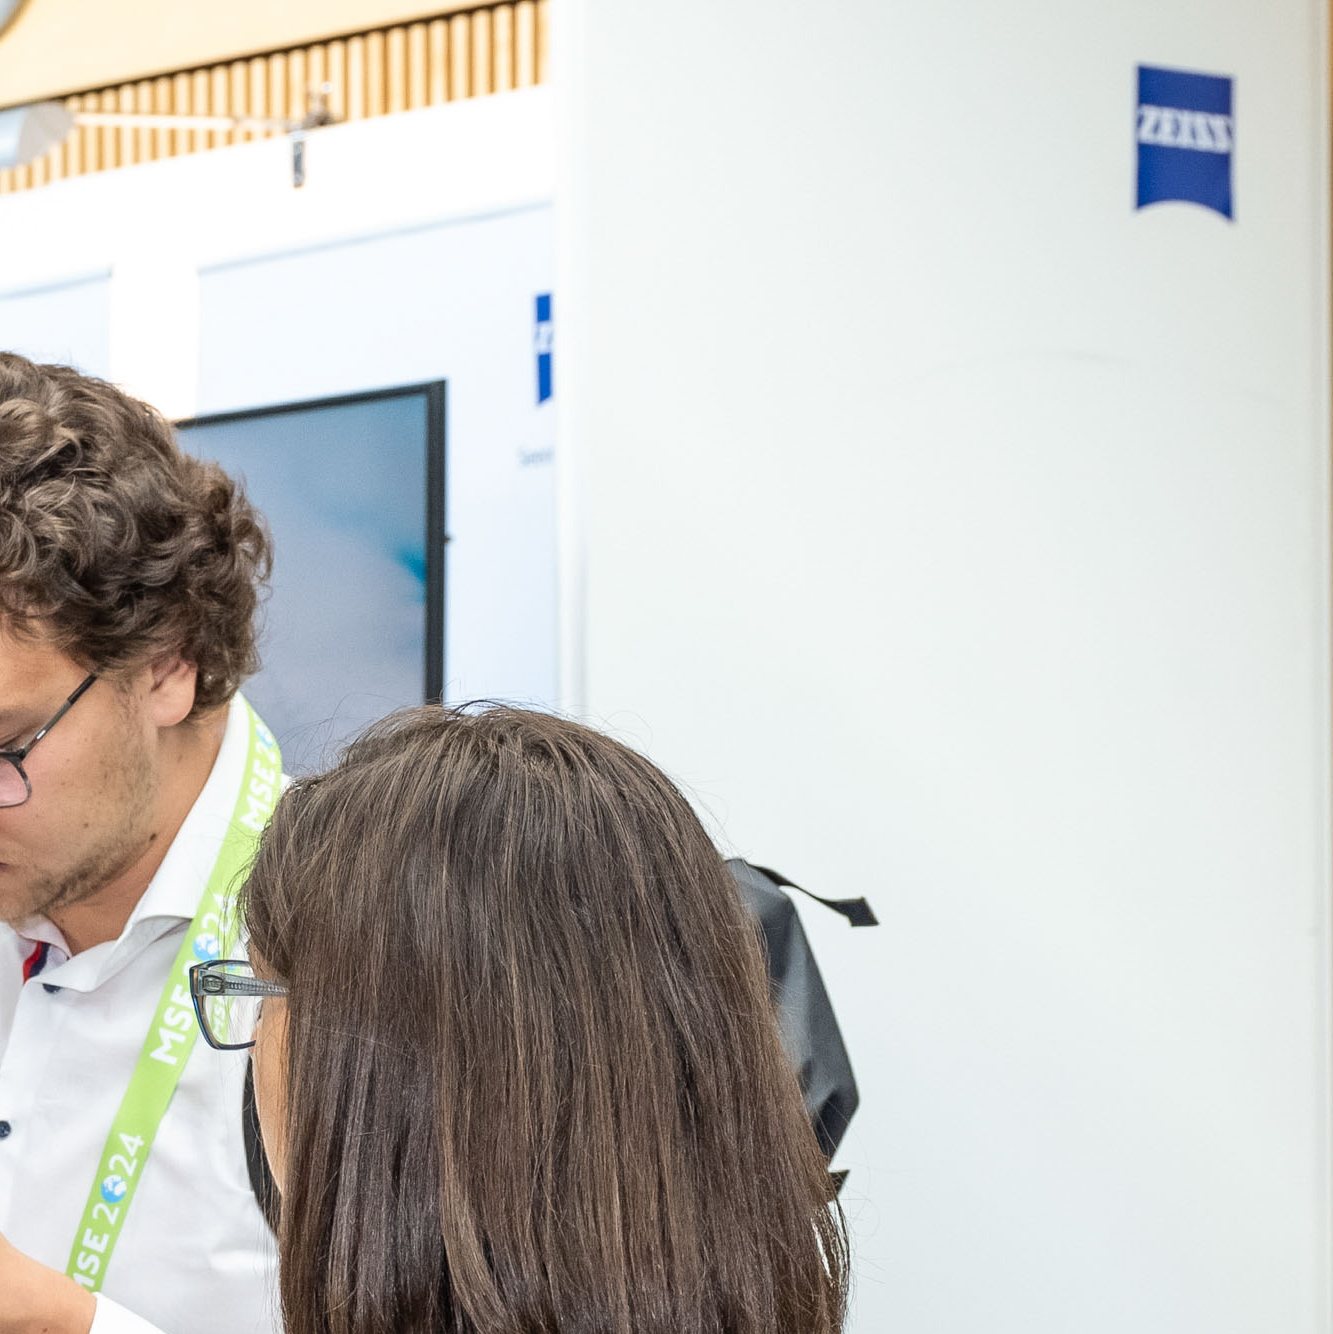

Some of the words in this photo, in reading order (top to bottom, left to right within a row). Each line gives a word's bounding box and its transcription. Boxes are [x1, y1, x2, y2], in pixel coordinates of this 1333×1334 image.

[1136, 104, 1233, 153] ZEISS
[240, 759, 276, 832] MSE
[93, 1132, 145, 1226] 2024
